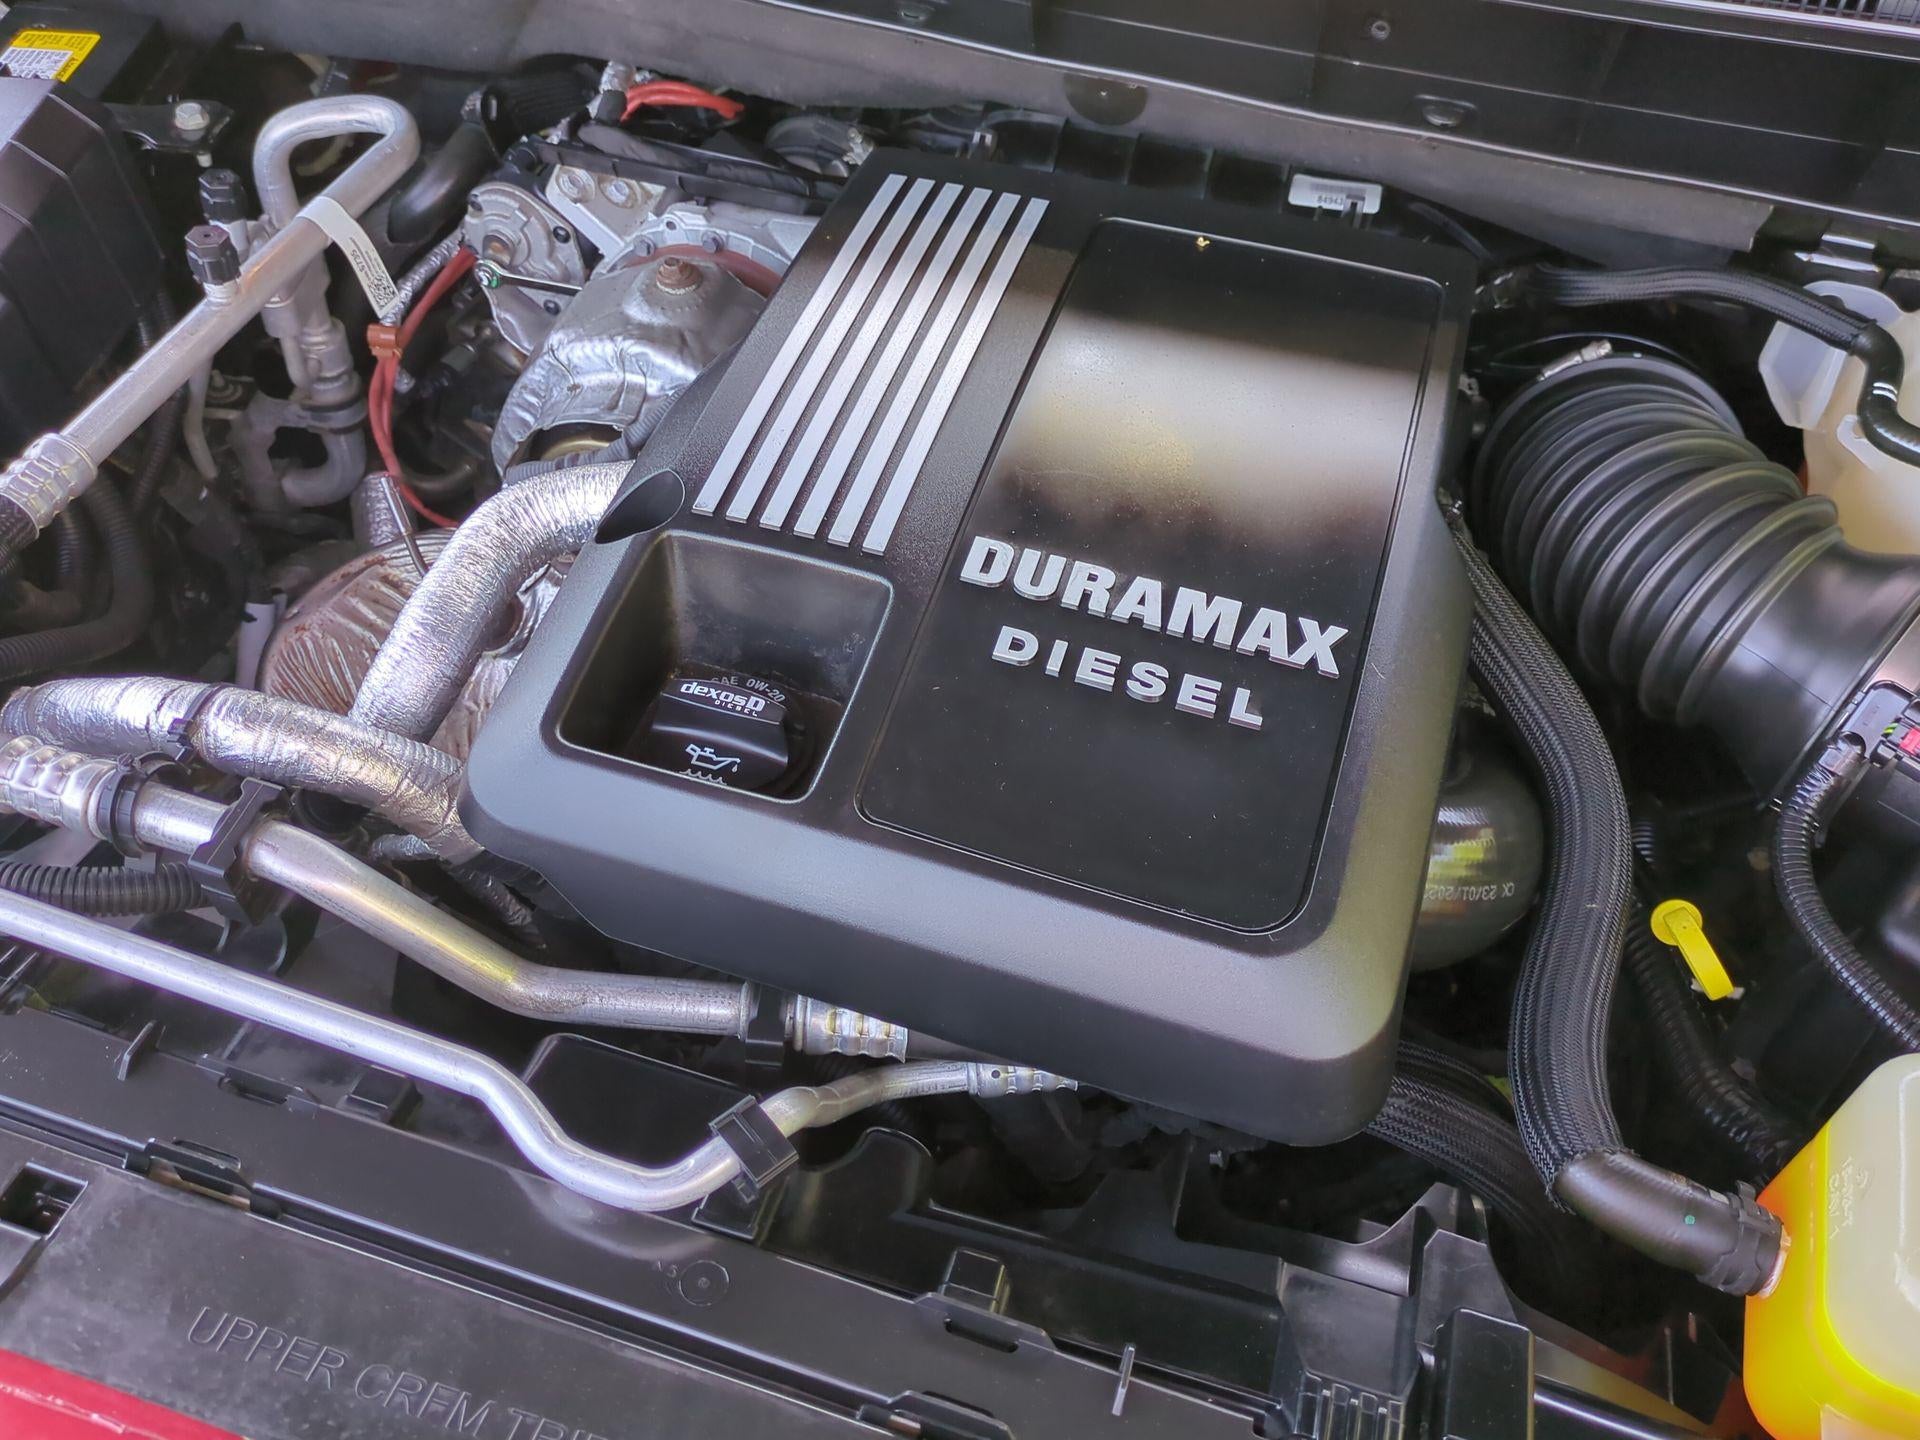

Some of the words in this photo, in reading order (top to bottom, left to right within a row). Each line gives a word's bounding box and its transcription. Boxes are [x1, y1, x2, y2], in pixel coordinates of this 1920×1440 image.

[959, 535, 1348, 679] DURAMAX
[714, 699, 758, 717] DIESEL
[746, 678, 786, 703] 0W-20
[991, 625, 1263, 731] DIESEL
[187, 1306, 351, 1390] UPPER
[354, 1363, 498, 1438] CRFM
